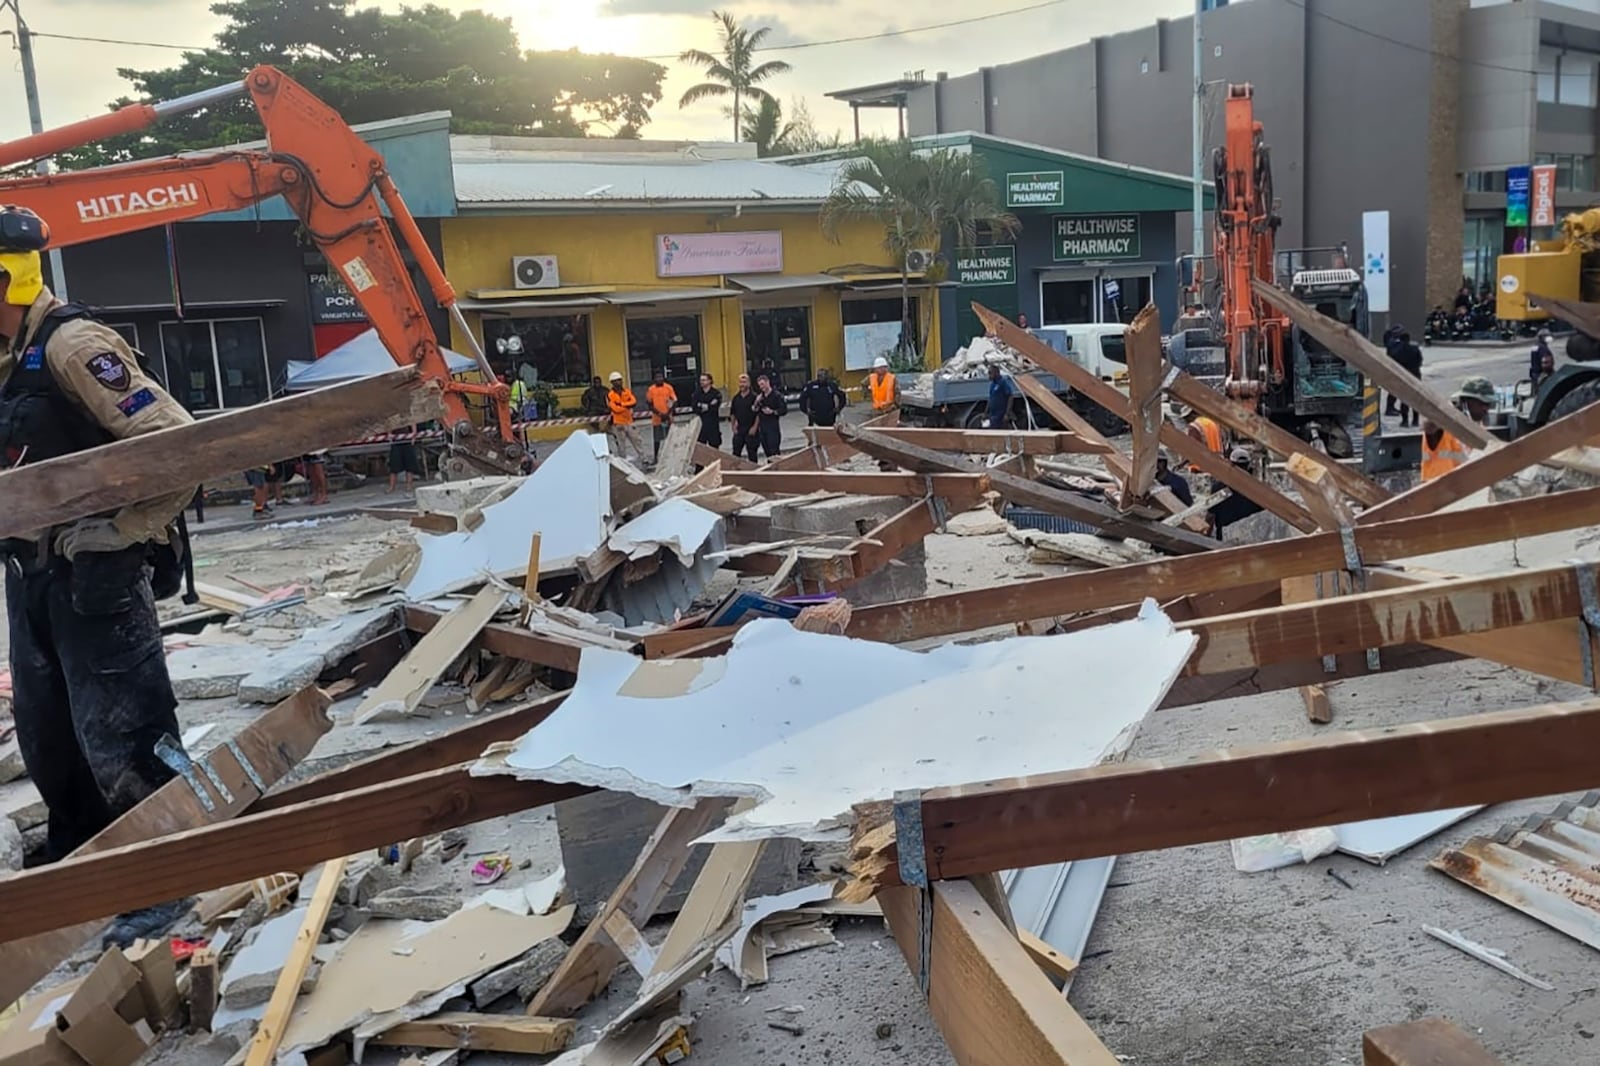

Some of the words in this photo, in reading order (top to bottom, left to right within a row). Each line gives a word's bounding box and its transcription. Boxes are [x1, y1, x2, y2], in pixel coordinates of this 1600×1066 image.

[1009, 181, 1060, 192] HEALTHWISE
[76, 182, 199, 219] HITACHI
[1013, 192, 1057, 203] PHARMACY
[1536, 171, 1551, 223] Digicel
[1058, 218, 1136, 235] HEALTHWISE
[1062, 238, 1131, 256] PHARMACY
[957, 257, 1012, 270] HEALTHWISE
[960, 269, 1009, 282] PHARMACY
